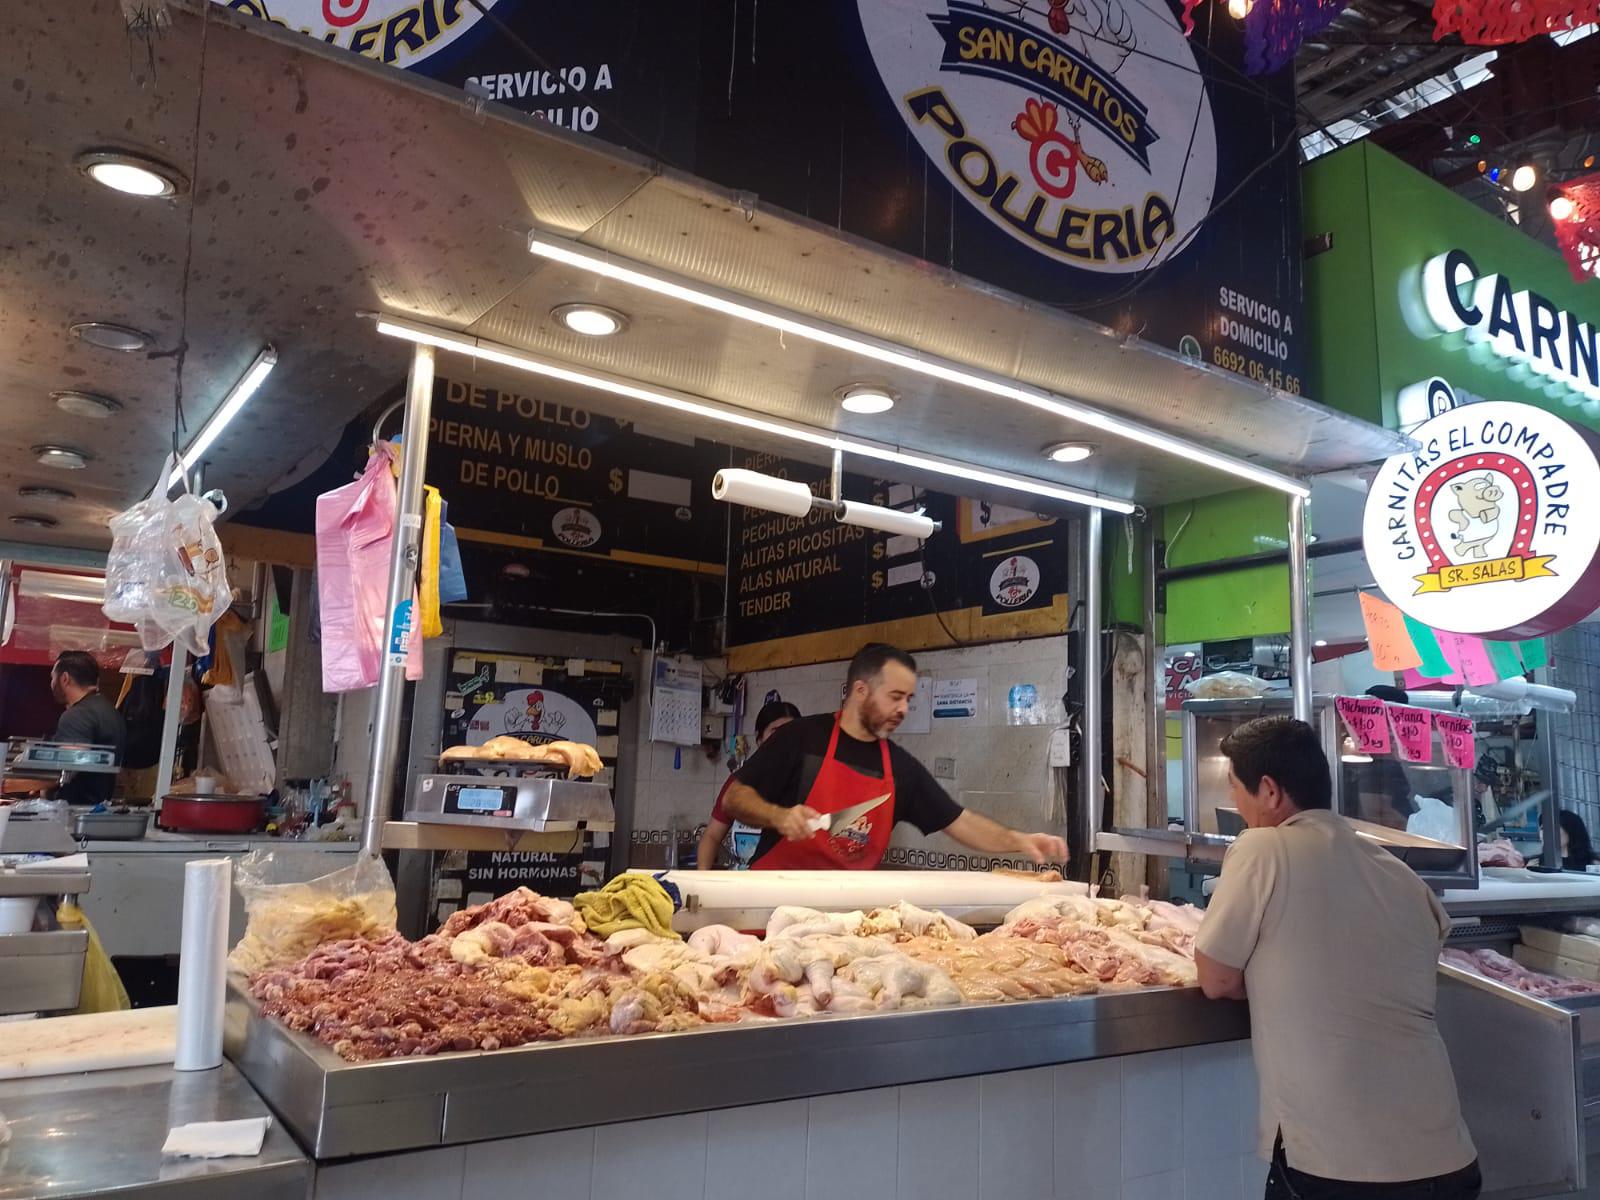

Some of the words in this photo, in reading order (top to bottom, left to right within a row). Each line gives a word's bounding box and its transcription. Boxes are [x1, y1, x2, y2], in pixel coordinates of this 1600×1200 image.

[594, 64, 613, 90] A
[958, 26, 1014, 63] SAN
[1019, 39, 1138, 143] CARLITOS
[904, 86, 1176, 264] POLLERIA
[1219, 286, 1281, 328] SERVICIO
[1283, 315, 1293, 335] A
[1220, 315, 1288, 360] DOMICILIO
[1213, 346, 1246, 375] 6692
[1285, 374, 1301, 395] 66
[446, 382, 488, 409] DE
[496, 391, 591, 430] POLLO
[508, 433, 521, 457] Y
[525, 436, 592, 471] MUSLO
[460, 459, 488, 486] DE
[494, 466, 560, 498] POLLO
[608, 467, 623, 495] $
[1388, 438, 1441, 560] CARNITAS
[1449, 426, 1475, 452] EL
[1481, 420, 1570, 536] COMPADRE
[740, 542, 784, 571] ALITAS
[787, 525, 865, 556] PICOSITAS
[742, 516, 804, 546] PECHUGA
[872, 542, 885, 561] $
[740, 566, 777, 593] ALAS
[776, 554, 842, 586] NATURAL
[871, 570, 884, 589] $
[1447, 568, 1469, 584] SR.
[1472, 560, 1516, 580] SALAS
[739, 591, 791, 618] TENDER
[468, 867, 494, 880] SIN
[498, 866, 577, 880] HORMONAS
[491, 851, 557, 863] NATURAL
